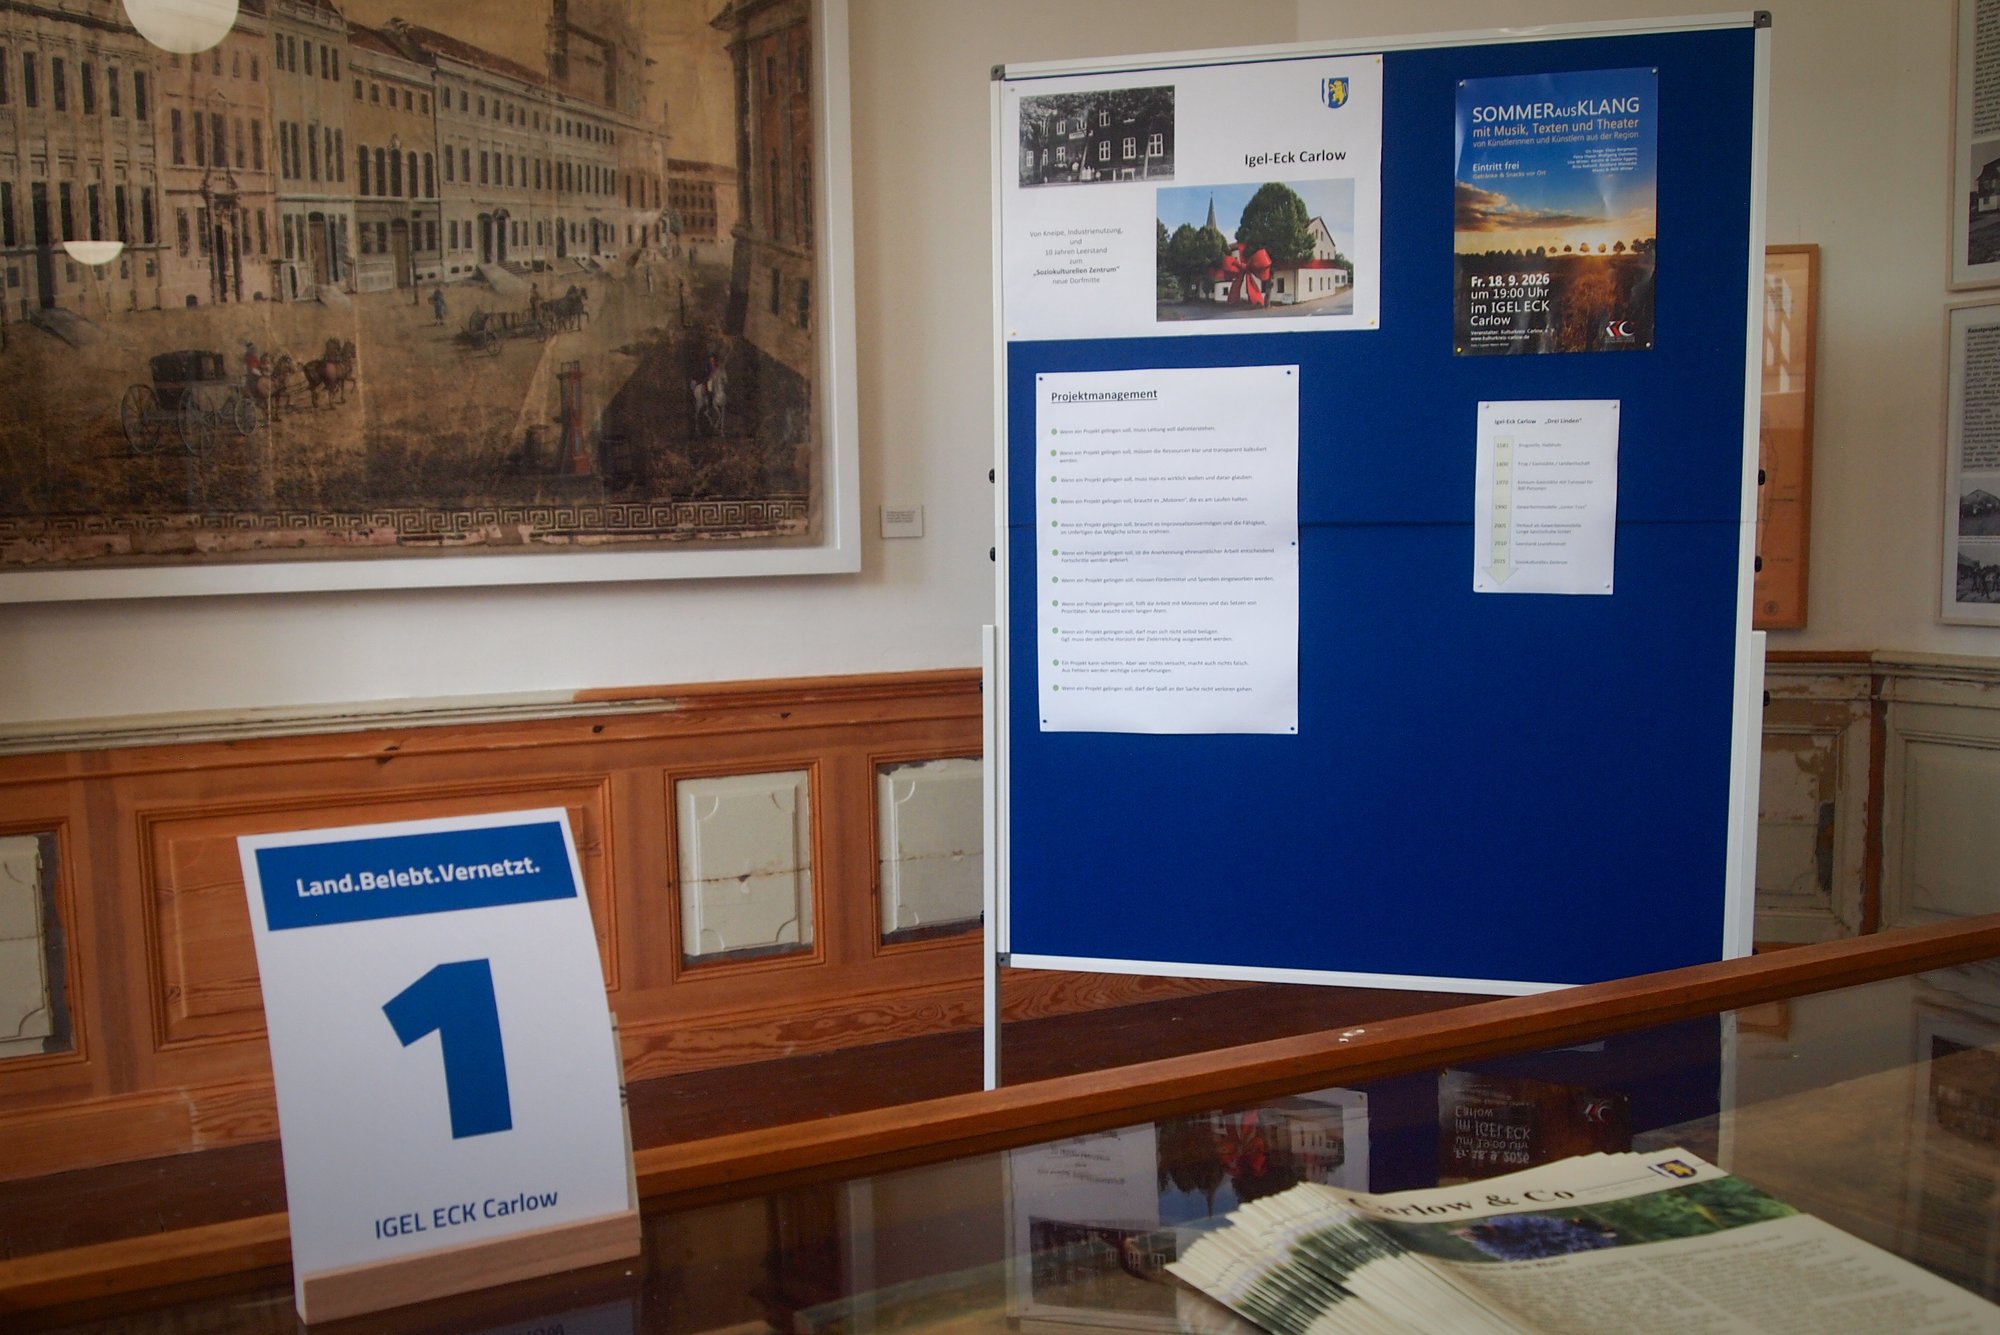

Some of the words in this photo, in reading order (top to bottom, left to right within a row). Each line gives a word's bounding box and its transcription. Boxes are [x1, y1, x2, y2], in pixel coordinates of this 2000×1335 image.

[1473, 125, 1490, 138] mit
[1494, 123, 1529, 137] Musik,
[1533, 122, 1568, 134] Texten
[1572, 120, 1592, 132] und
[1598, 118, 1638, 130] Theater
[1473, 140, 1486, 148] von
[1537, 135, 1550, 144] und
[1600, 132, 1612, 140] der
[1614, 131, 1639, 139] Region
[1244, 152, 1296, 168] Igel-Eck
[1300, 149, 1346, 163] Carlow
[1473, 162, 1502, 172] Eintritt
[1505, 161, 1519, 170] frei
[1068, 227, 1123, 235] Industrienutzung,
[1471, 276, 1485, 288] Fr.
[1489, 275, 1505, 286] 18.
[1509, 275, 1519, 286] 9.
[1522, 273, 1550, 285] 2026
[1471, 290, 1489, 300] um
[1494, 289, 1524, 299] 19:00
[1528, 287, 1549, 297] Uhr
[1471, 302, 1487, 314] im
[1492, 301, 1521, 313] IGEL
[1524, 300, 1550, 312] ECK
[1471, 315, 1511, 326] Carlow
[1051, 390, 1158, 403] Projektmanagement
[296, 856, 541, 898] Land.Belebt.Vernetzt.
[382, 958, 513, 1140] 1
[1486, 1194, 1519, 1208] &
[1523, 1189, 1576, 1203] Co
[375, 1212, 427, 1240] IGEL
[433, 1204, 477, 1229] ECK
[482, 1191, 558, 1220] Carlow
